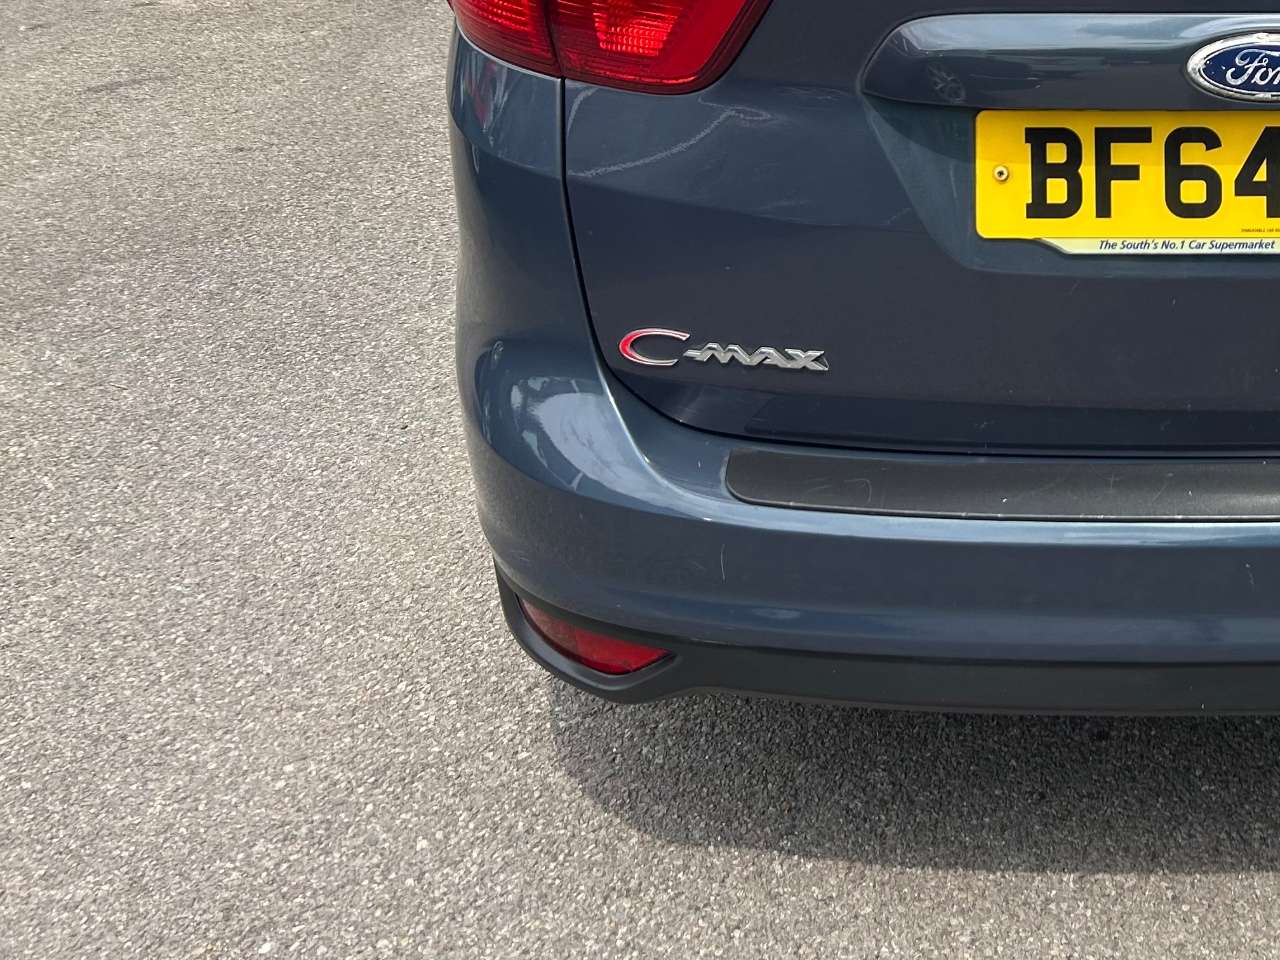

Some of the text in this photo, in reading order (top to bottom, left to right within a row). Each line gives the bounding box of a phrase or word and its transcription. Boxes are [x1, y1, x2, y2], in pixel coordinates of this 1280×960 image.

[1099, 239, 1276, 253] The South's No.1 Car Supermarket
